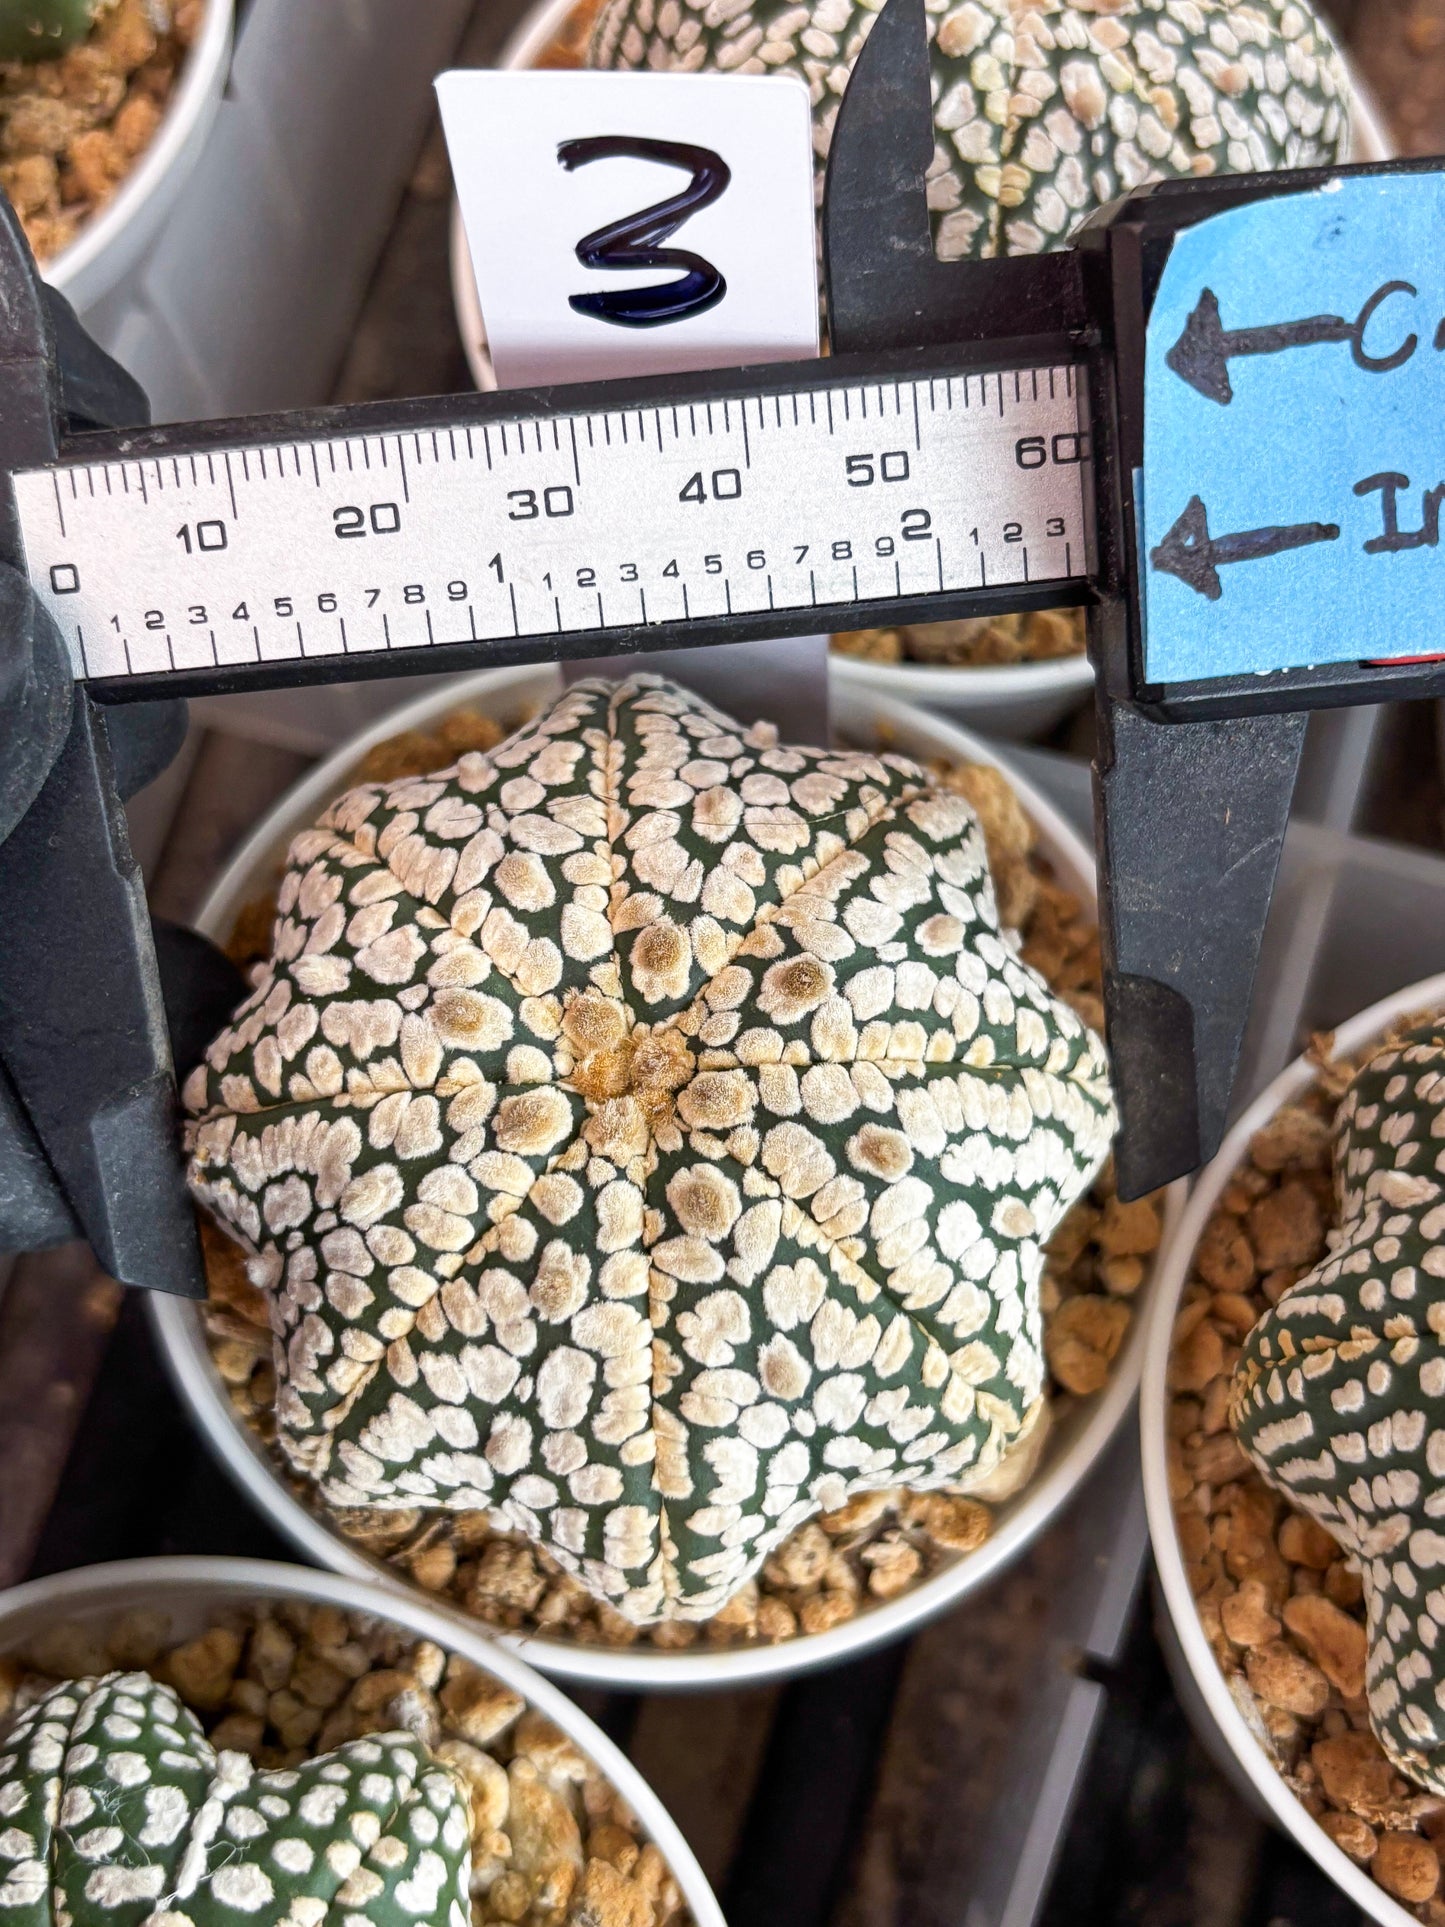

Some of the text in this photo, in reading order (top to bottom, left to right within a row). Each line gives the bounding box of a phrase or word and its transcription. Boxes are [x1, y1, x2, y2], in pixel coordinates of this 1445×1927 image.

[557, 136, 731, 328] 3
[1350, 280, 1445, 374] C
[49, 433, 1081, 595] 0 10 20 30 40 50 60
[111, 509, 1065, 632] 1 2 3 4 5 6 7 8 9 1 1 2 3 4 5 6 7 8 9 2 1 2 3
